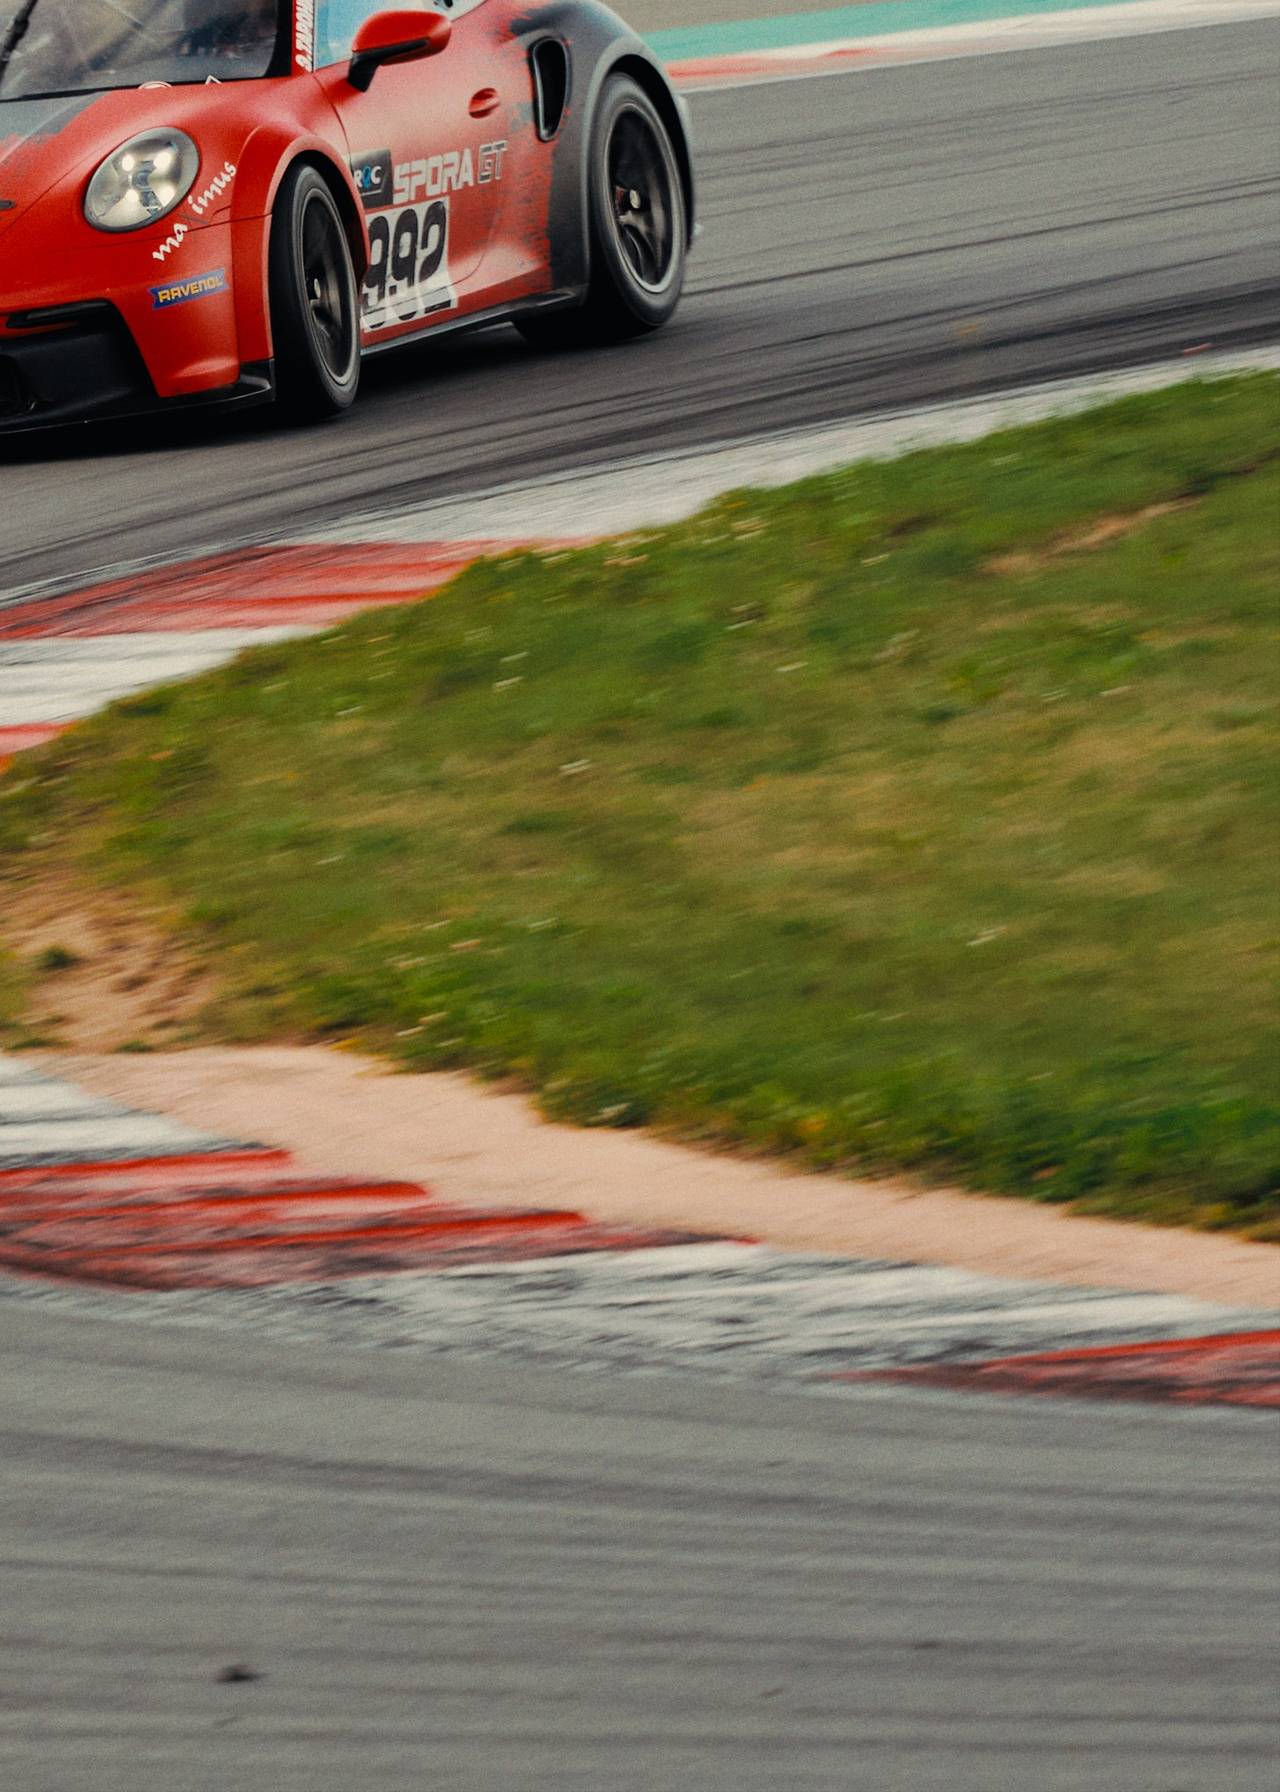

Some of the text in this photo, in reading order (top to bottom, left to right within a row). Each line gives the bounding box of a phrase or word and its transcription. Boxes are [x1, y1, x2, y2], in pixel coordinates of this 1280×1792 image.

[392, 139, 508, 205] SPORA GT
[157, 275, 224, 303] RAVENOL
[361, 200, 452, 329] 992
